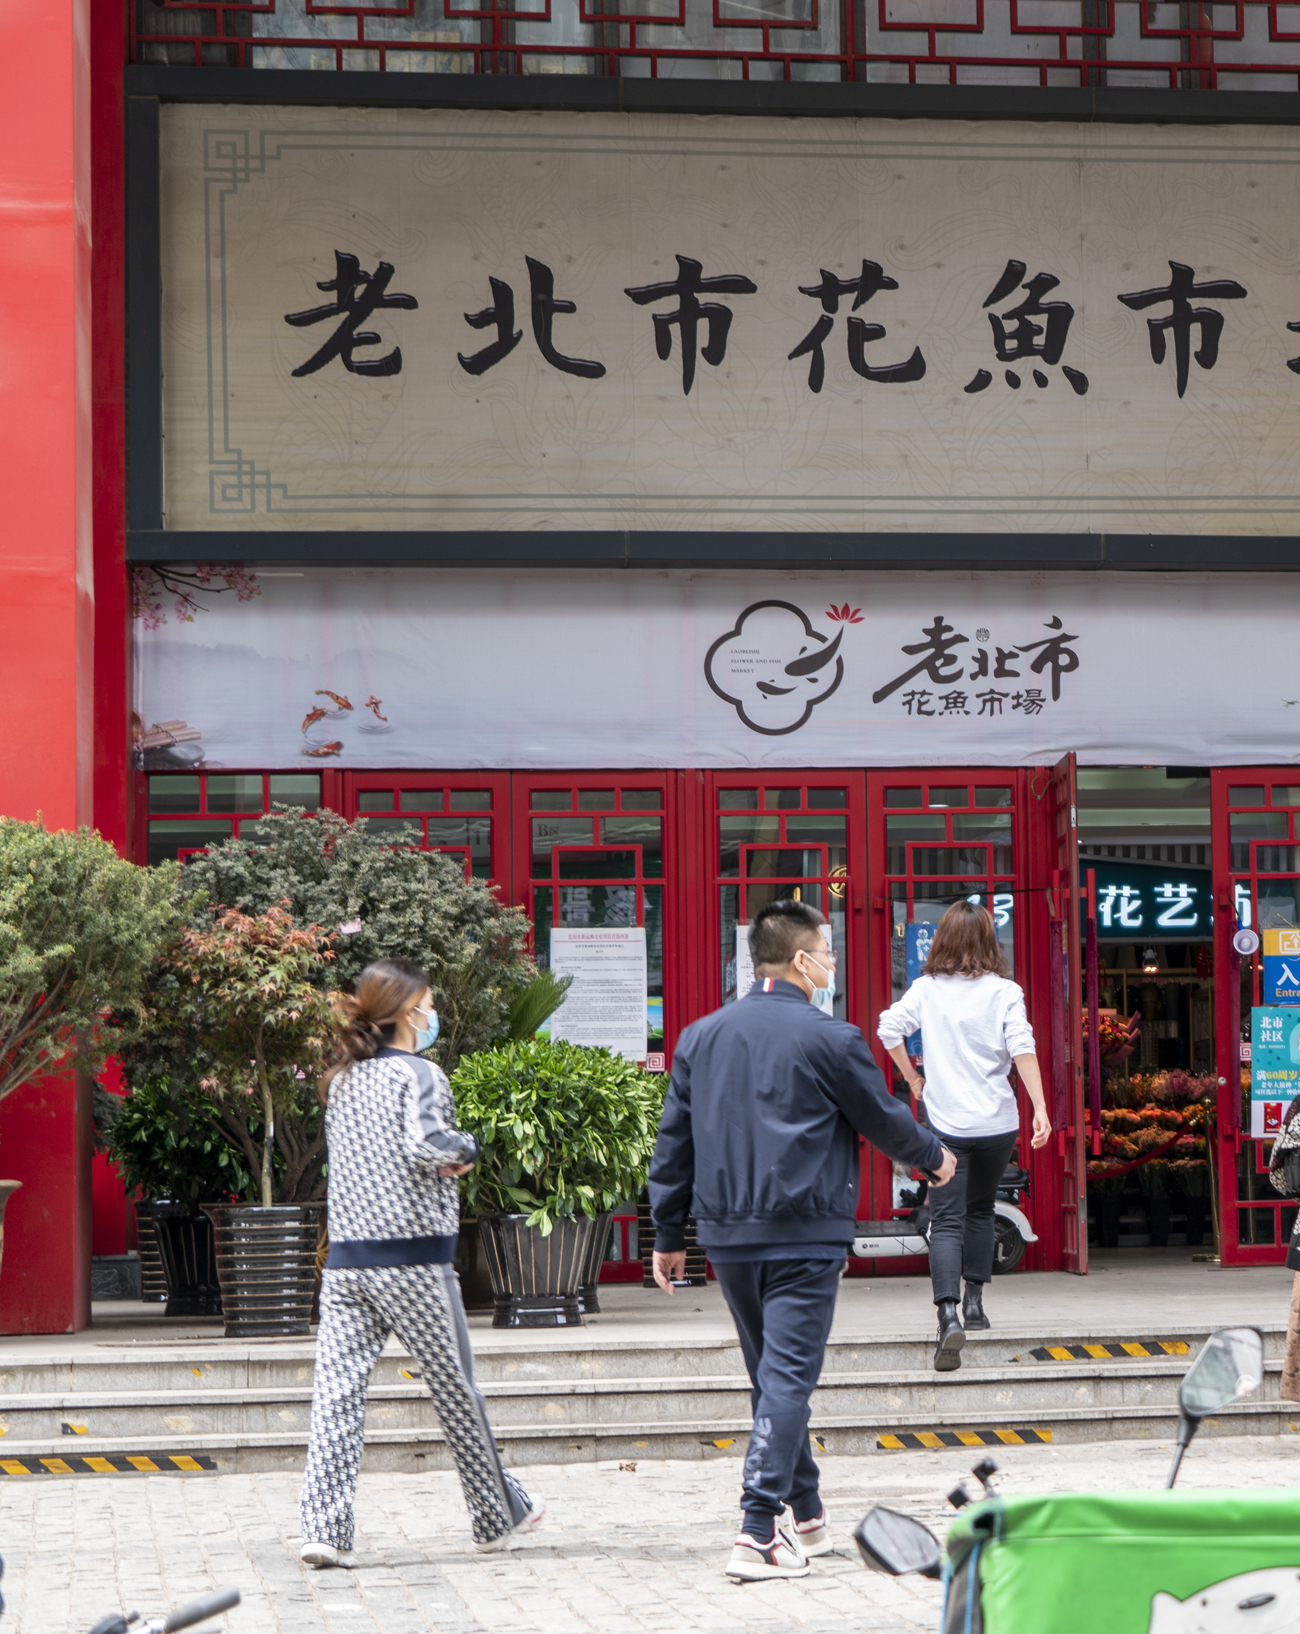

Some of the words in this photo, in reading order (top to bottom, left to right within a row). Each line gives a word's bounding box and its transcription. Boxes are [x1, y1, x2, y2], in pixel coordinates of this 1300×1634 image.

[872, 615, 1080, 703] 老北市
[901, 688, 1047, 717] 花魚市場
[1260, 1016, 1284, 1029] 北市
[1260, 1030, 1284, 1042] 社区
